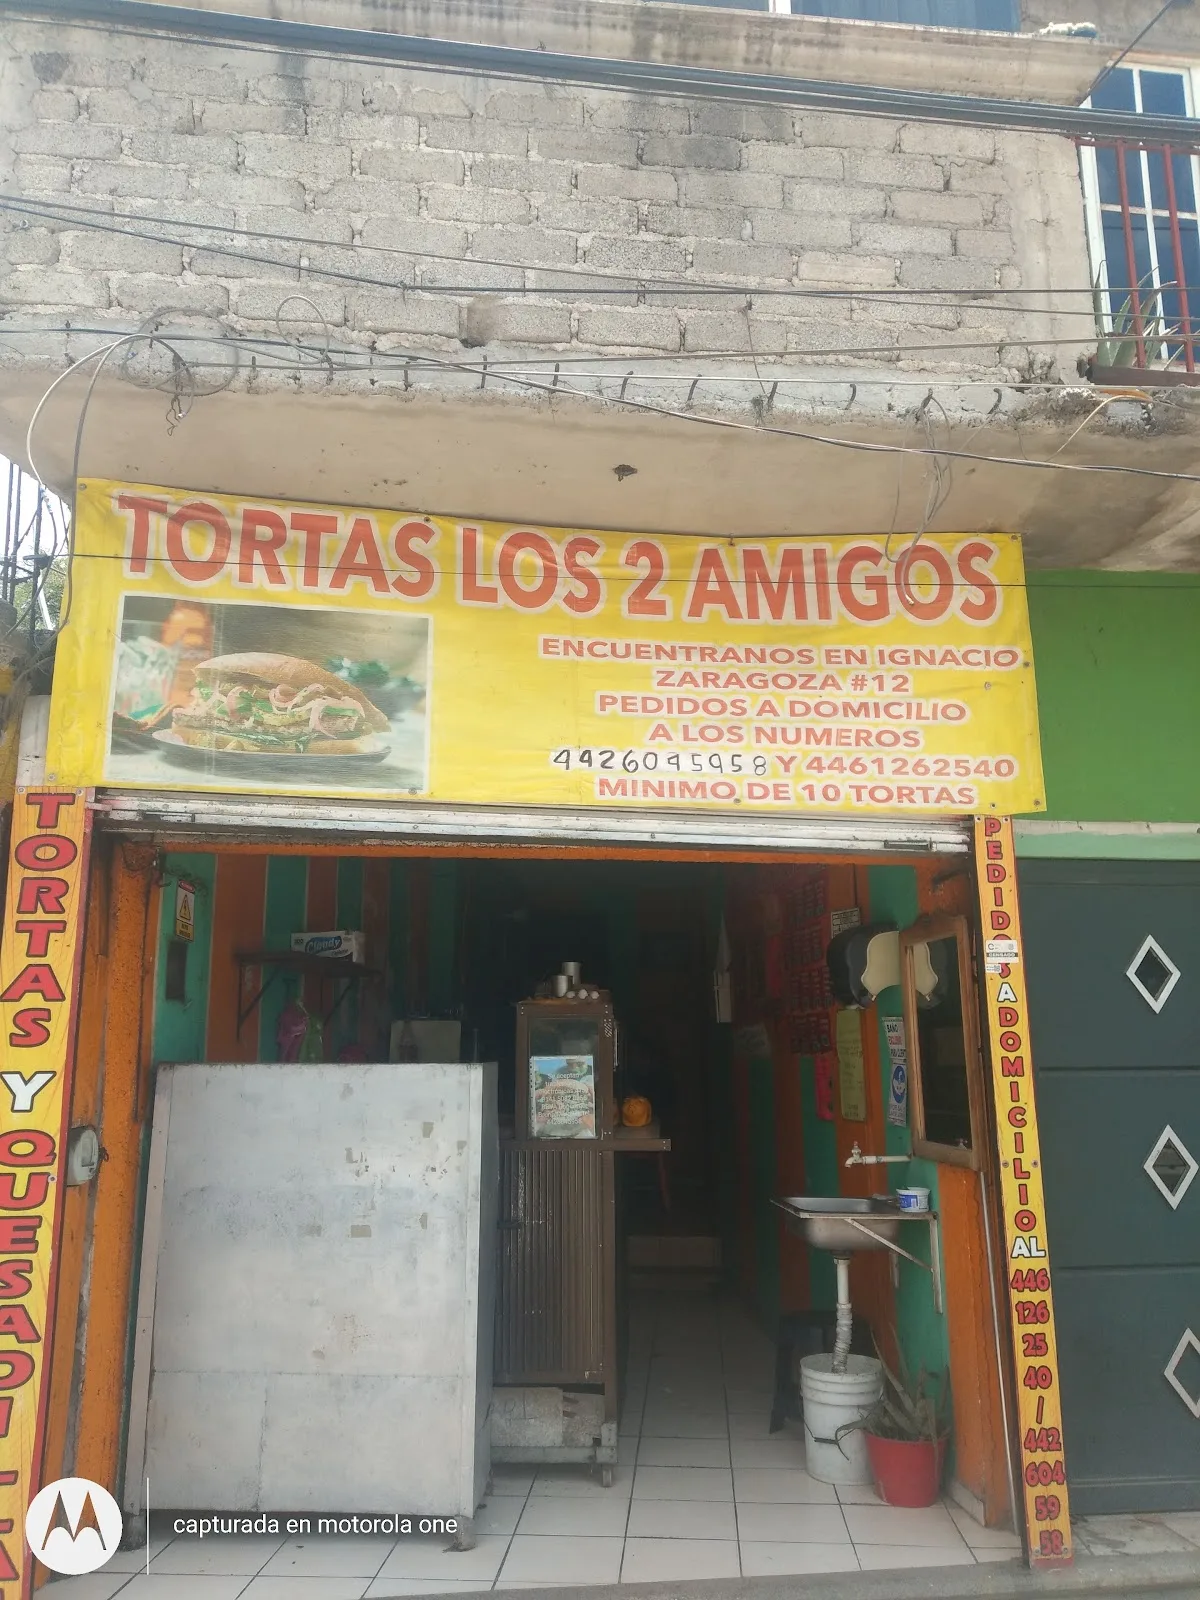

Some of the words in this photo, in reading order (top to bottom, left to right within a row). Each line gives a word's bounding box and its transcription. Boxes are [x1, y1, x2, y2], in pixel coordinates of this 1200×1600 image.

[116, 494, 437, 599] TORTAS
[461, 525, 603, 615] LOS
[624, 539, 668, 617] 2
[687, 540, 997, 622] AMIGOS
[541, 637, 815, 665] ENCUENTRANOS
[824, 647, 868, 666] EN
[877, 648, 1020, 668] IGNACIO
[656, 670, 842, 691] ZARAGOZA
[851, 674, 909, 693] #12
[599, 695, 747, 717] PEDIDOS
[757, 699, 779, 717] A
[788, 700, 967, 721] DOMICILIO
[650, 723, 672, 741] A
[682, 725, 744, 743] LOS
[755, 726, 920, 748] NUMEROS
[775, 755, 797, 773] Y
[805, 756, 1015, 778] 4461262540
[598, 778, 736, 800] MINIMO
[747, 782, 790, 801] DE
[803, 784, 841, 803] 10
[852, 785, 975, 806] TORTAS
[1, 792, 78, 1048] TORTAS
[996, 981, 1018, 1003] A
[1, 1071, 57, 1113] Y
[998, 1006, 1037, 1232] DOMICILIO
[1011, 1236, 1047, 1259] AL
[1010, 1268, 1050, 1292] 446
[1015, 1301, 1050, 1325] 126
[1022, 1333, 1048, 1357] 25
[1023, 1366, 1052, 1389] 40
[1023, 1427, 1061, 1452] 442
[1024, 1460, 1065, 1487] 604
[1034, 1496, 1061, 1521] 59
[1039, 1530, 1064, 1556] 58
